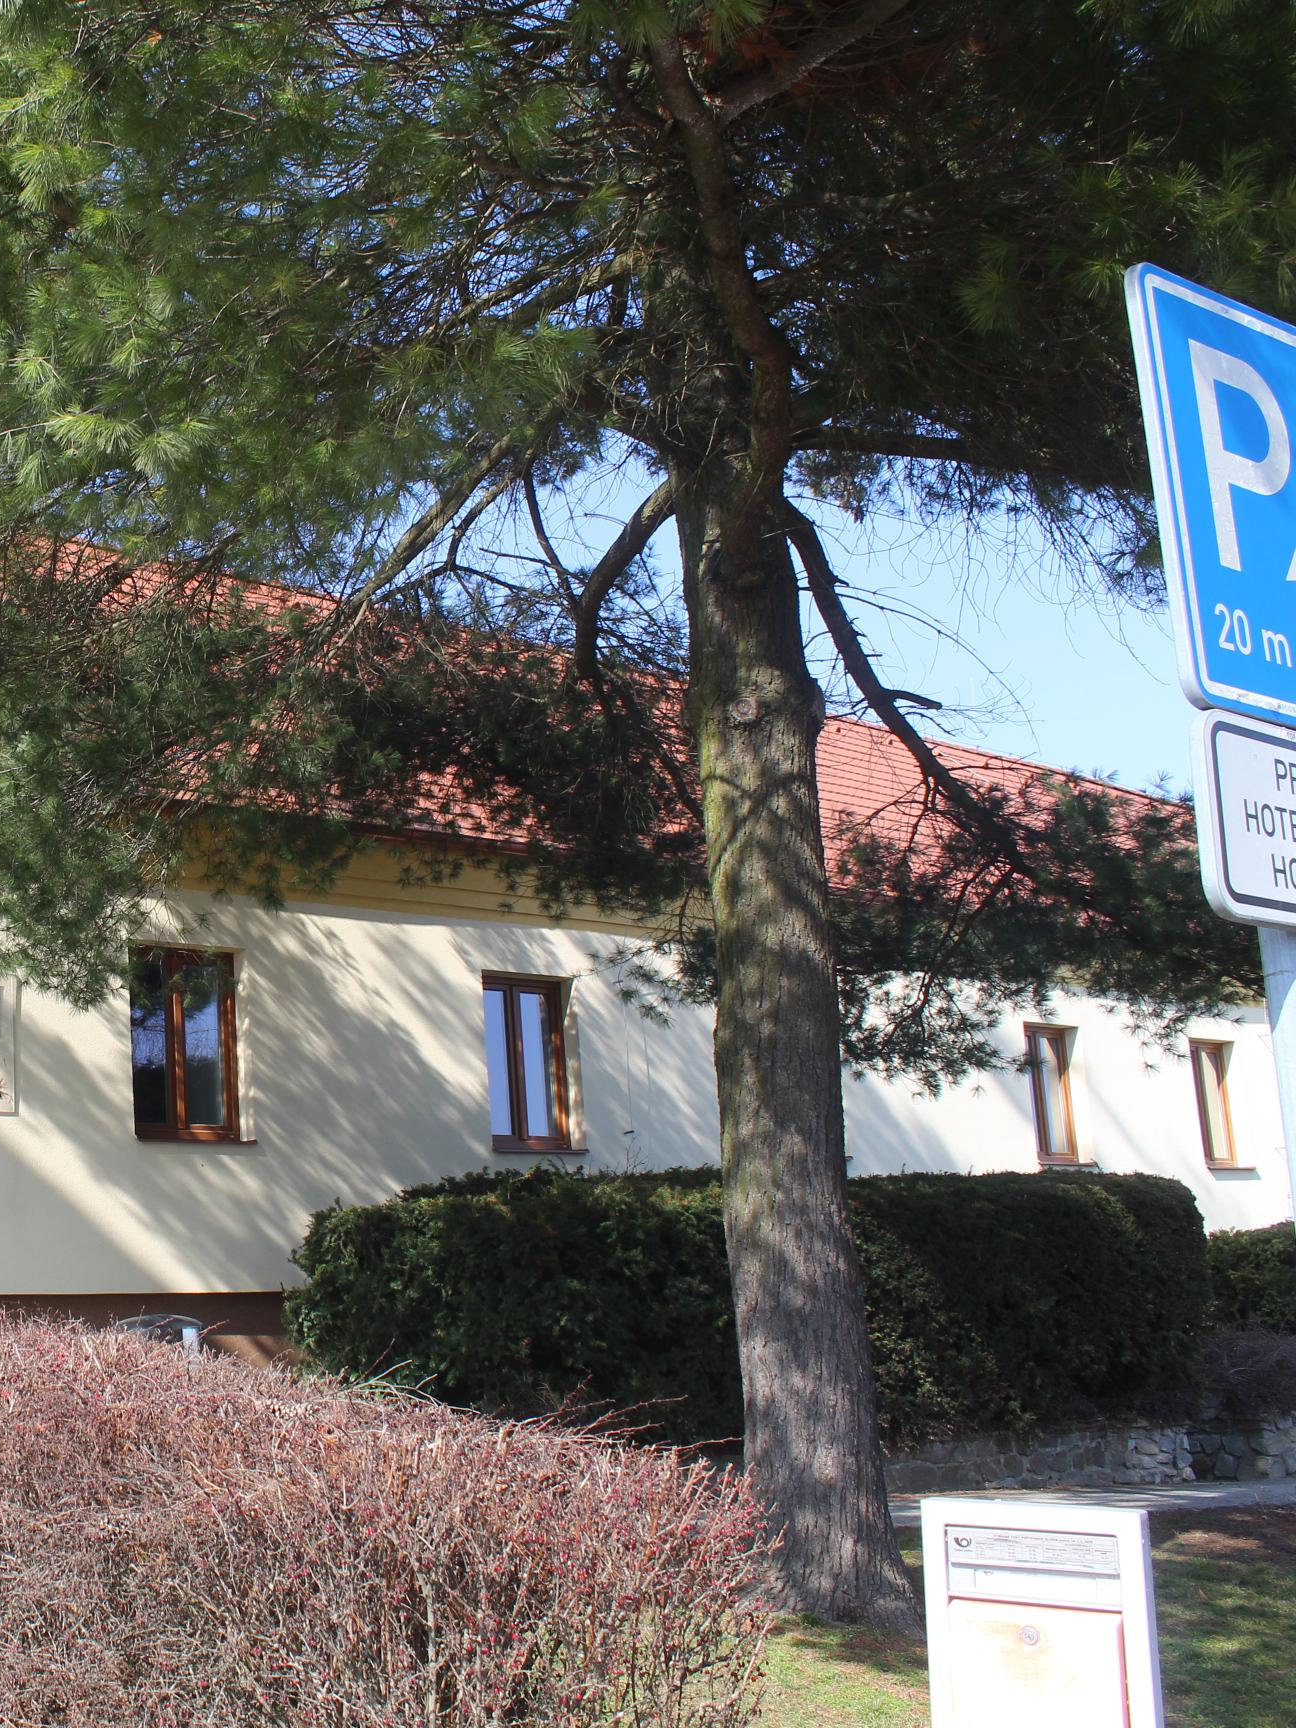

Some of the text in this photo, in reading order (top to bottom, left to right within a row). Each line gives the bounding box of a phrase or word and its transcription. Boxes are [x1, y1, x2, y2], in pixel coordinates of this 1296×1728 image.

[1188, 338, 1290, 571] P
[1214, 603, 1293, 668] 20 m
